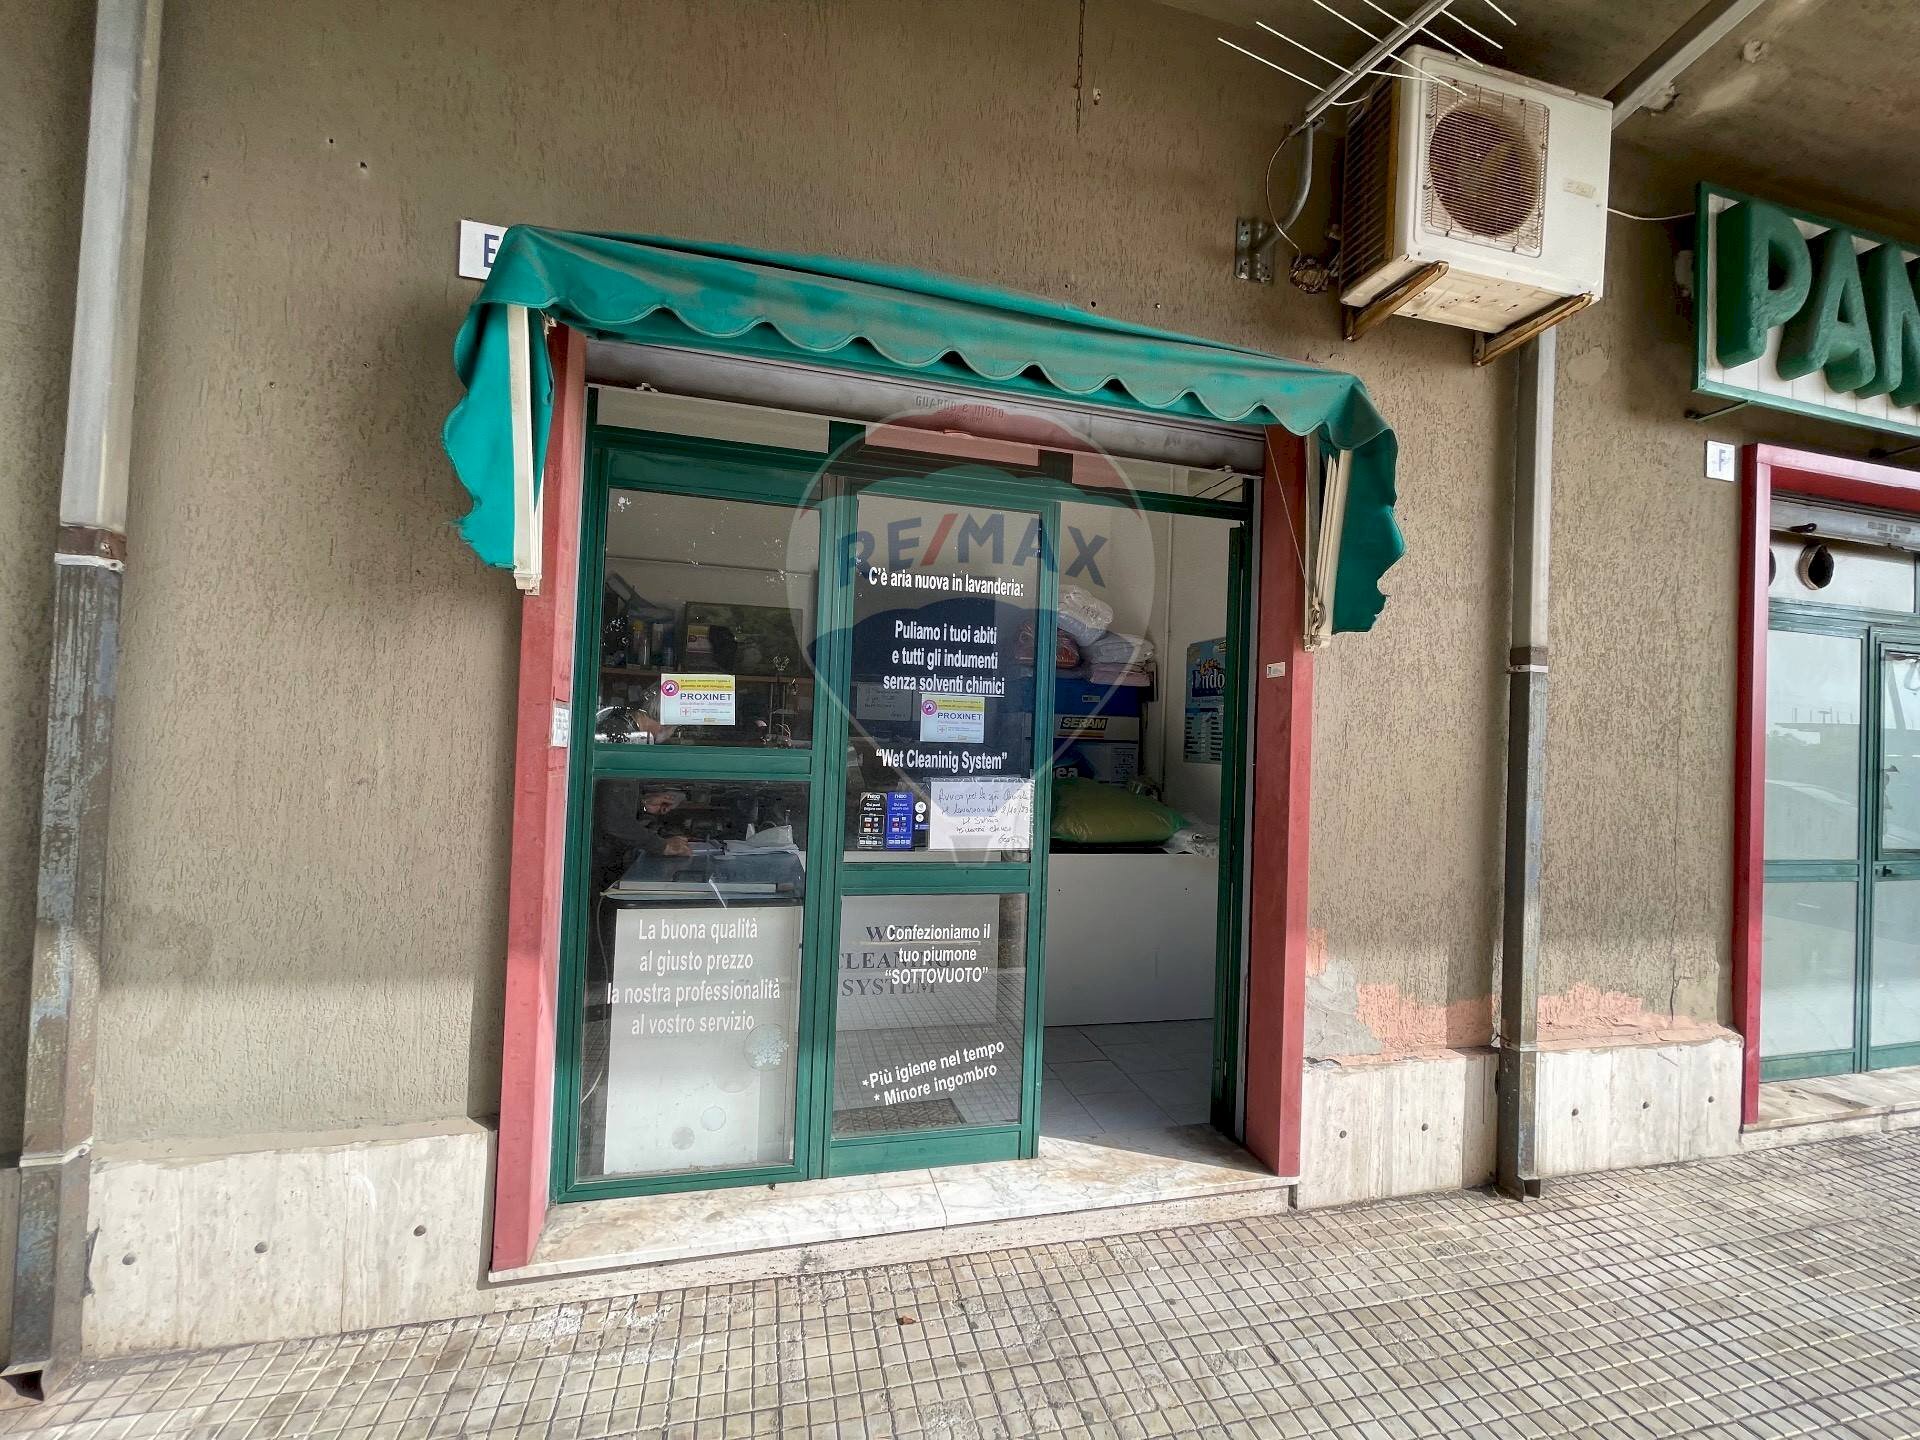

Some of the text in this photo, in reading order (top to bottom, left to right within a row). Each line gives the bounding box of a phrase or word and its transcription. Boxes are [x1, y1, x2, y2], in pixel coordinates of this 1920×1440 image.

[484, 233, 500, 268] E
[868, 566, 1024, 597] C’è aria nuova in lavanderia:
[894, 619, 998, 645] Puliamo i tuoi abiti
[891, 647, 998, 671] e tutti gli indumenti
[680, 692, 733, 701] PROXINET
[883, 674, 1005, 695] senza solventi chimici
[937, 712, 983, 721] PROXINET
[1062, 717, 1107, 729] SERAM
[875, 748, 1008, 774] “Wet Cleaninig System”
[638, 917, 758, 945] La buona qualità
[886, 923, 991, 940] Confezioniamo il
[639, 949, 753, 977] al giusto prezzo
[899, 946, 977, 965] tuo piumone
[884, 966, 989, 985] “SOTTOVUOTO”
[606, 977, 781, 1008] la nostra professionalità
[631, 1010, 755, 1035] al vostro servizio
[895, 1059, 937, 1083] igiene
[939, 1049, 961, 1069] nel
[962, 1041, 1005, 1063] tempo
[883, 1064, 997, 1106] Minore ingombro
